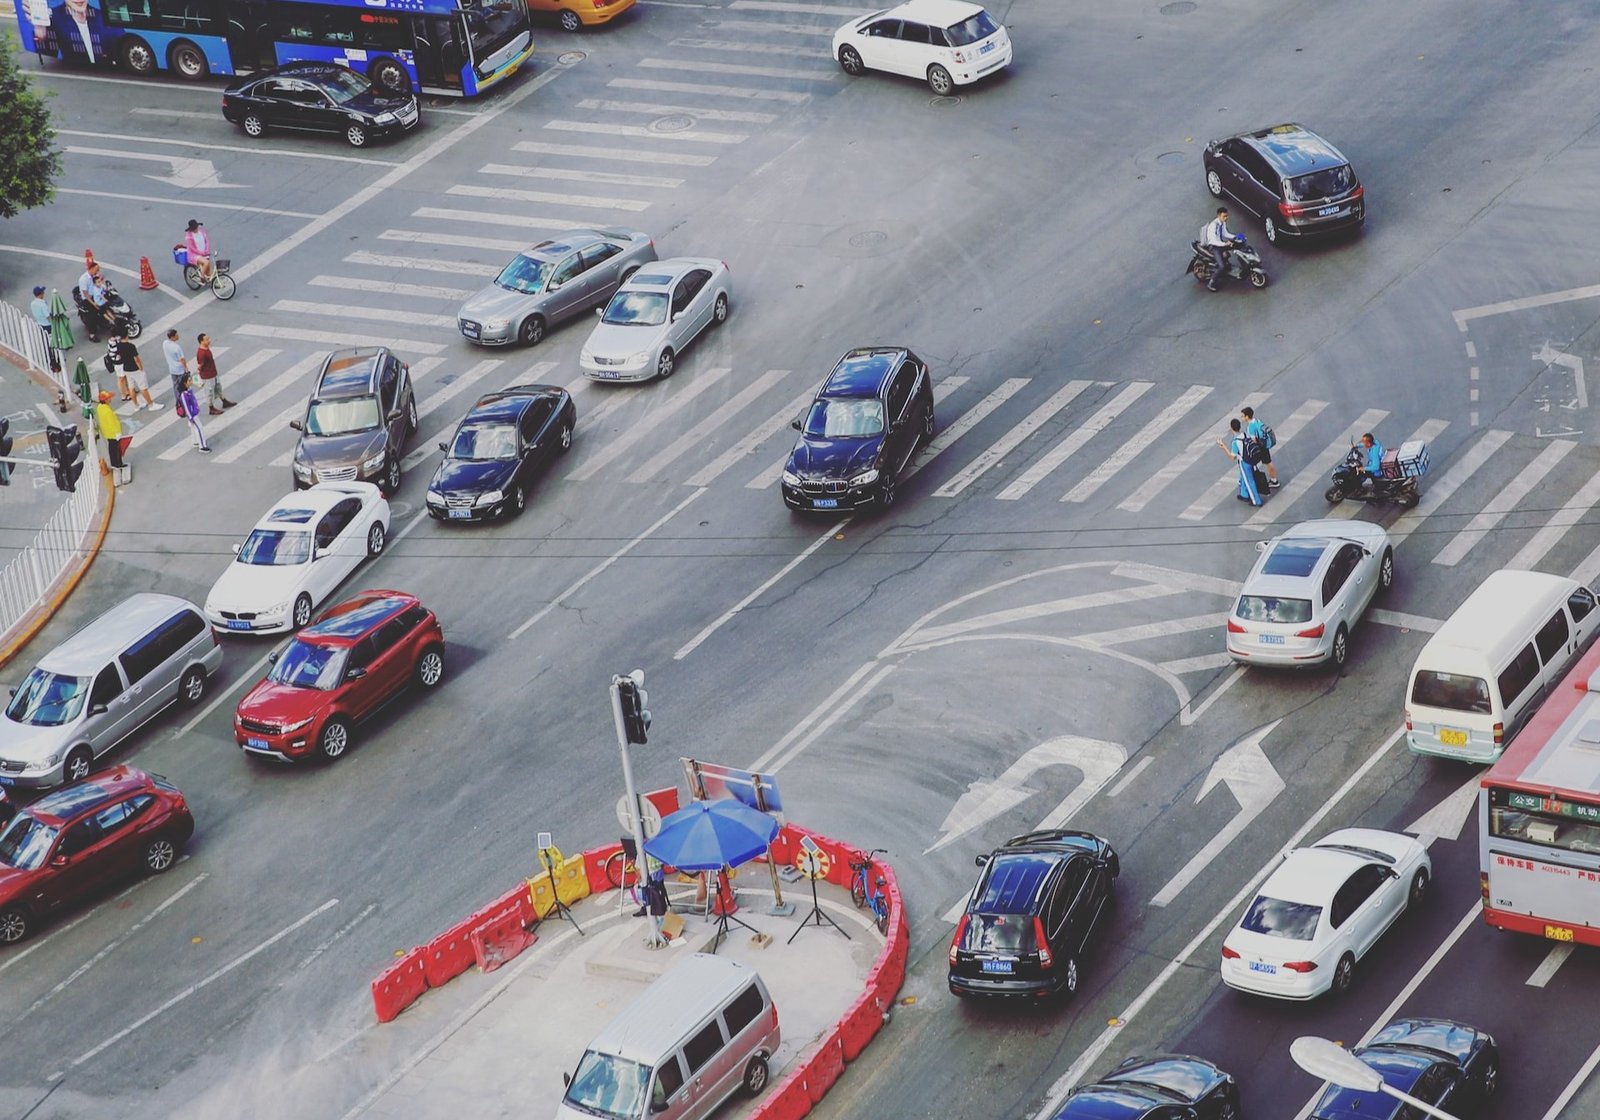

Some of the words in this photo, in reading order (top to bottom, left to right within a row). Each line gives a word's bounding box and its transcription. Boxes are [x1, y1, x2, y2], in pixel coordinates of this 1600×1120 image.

[1514, 795, 1535, 807] 公交
[1496, 856, 1534, 871] 保持车距
